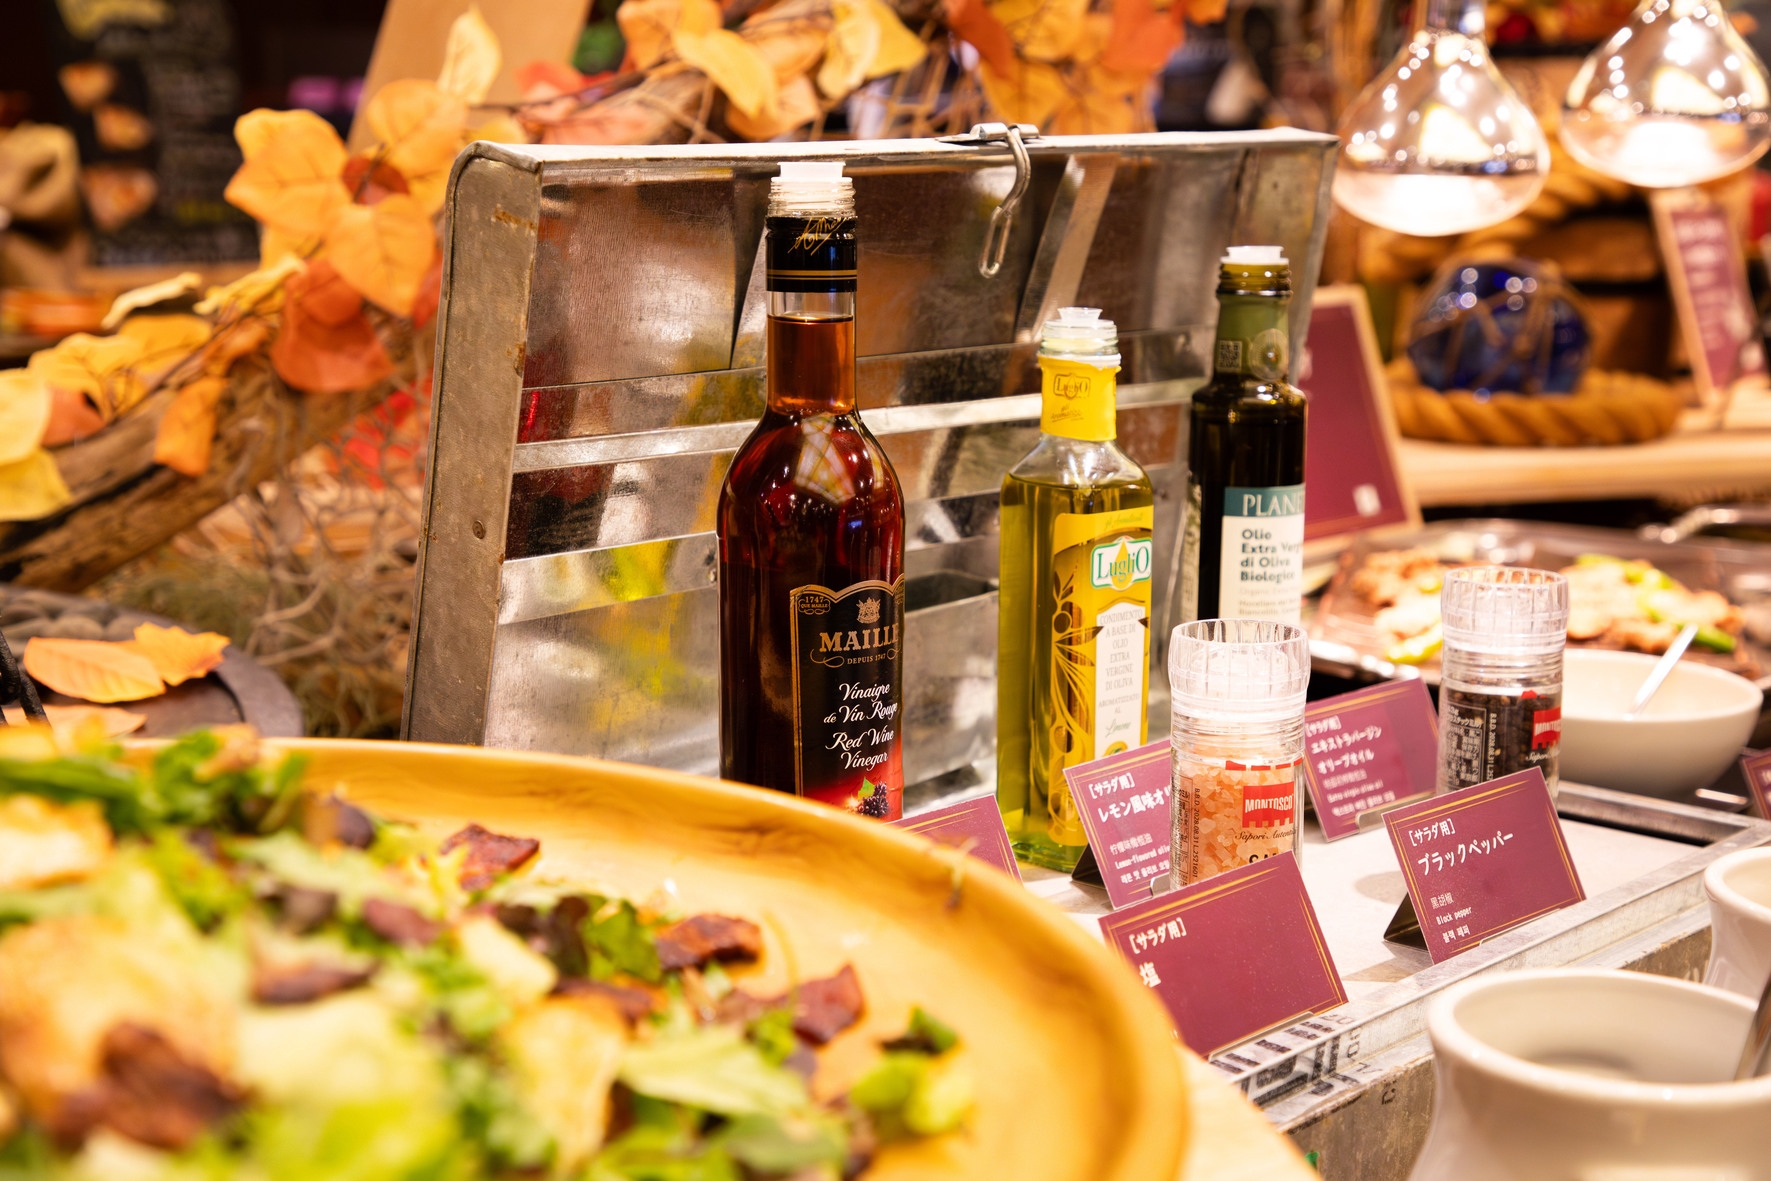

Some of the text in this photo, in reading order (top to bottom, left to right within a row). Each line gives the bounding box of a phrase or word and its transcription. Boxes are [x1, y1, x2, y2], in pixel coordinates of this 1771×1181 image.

[1241, 528, 1272, 540] Olio
[1241, 542, 1277, 554] Extra
[1096, 546, 1150, 583] LugliO
[1240, 556, 1290, 568] di Oliva
[1240, 570, 1295, 584] Biologico
[805, 596, 824, 604] 1747
[1099, 608, 1143, 626] CONDIMENTO
[819, 622, 899, 653] MAILLE
[1105, 623, 1136, 638] A BASE DI
[1112, 637, 1128, 650] OLIO
[847, 655, 874, 665] DEPUIS
[1110, 650, 1130, 664] EXTRA
[1105, 663, 1134, 677] VERGINE
[838, 681, 891, 702] Vinaigre
[1106, 677, 1134, 691] DI OLIVA
[823, 699, 898, 724] de Vin Rouge
[825, 724, 895, 751] Red Wine
[1311, 725, 1382, 754] エキストラバージン
[840, 750, 889, 772] Vinegar
[1317, 748, 1375, 774] オリーブオイル
[1245, 795, 1293, 814] MONTOSCO
[1193, 807, 1201, 842] 2028.08.31
[1235, 831, 1267, 843] Sapori
[1418, 830, 1514, 876] ブラックペッパー
[1454, 906, 1473, 920] pepper
[1139, 961, 1162, 988] 塩
